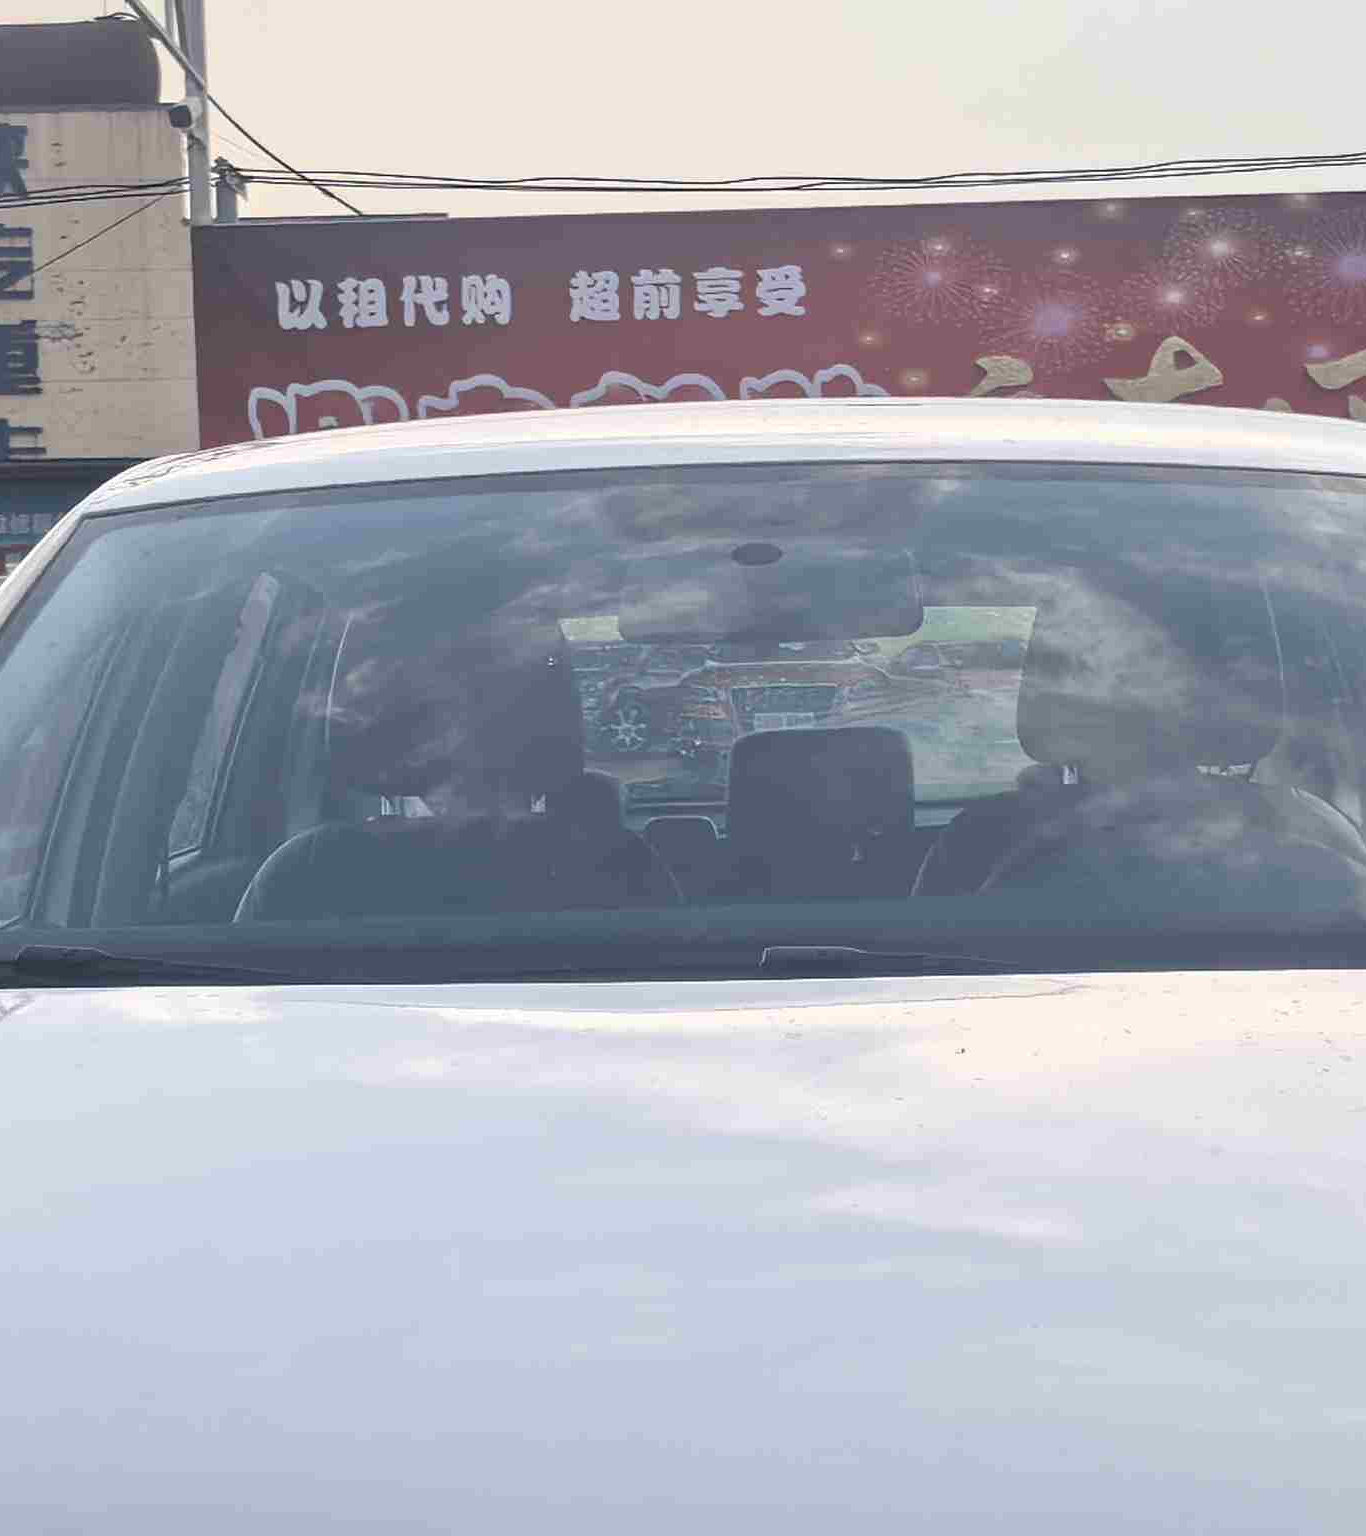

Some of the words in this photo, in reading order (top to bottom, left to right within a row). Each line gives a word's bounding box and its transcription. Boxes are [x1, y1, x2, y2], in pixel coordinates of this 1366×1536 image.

[275, 274, 513, 330] 以租代购
[568, 264, 808, 323] 超前享受
